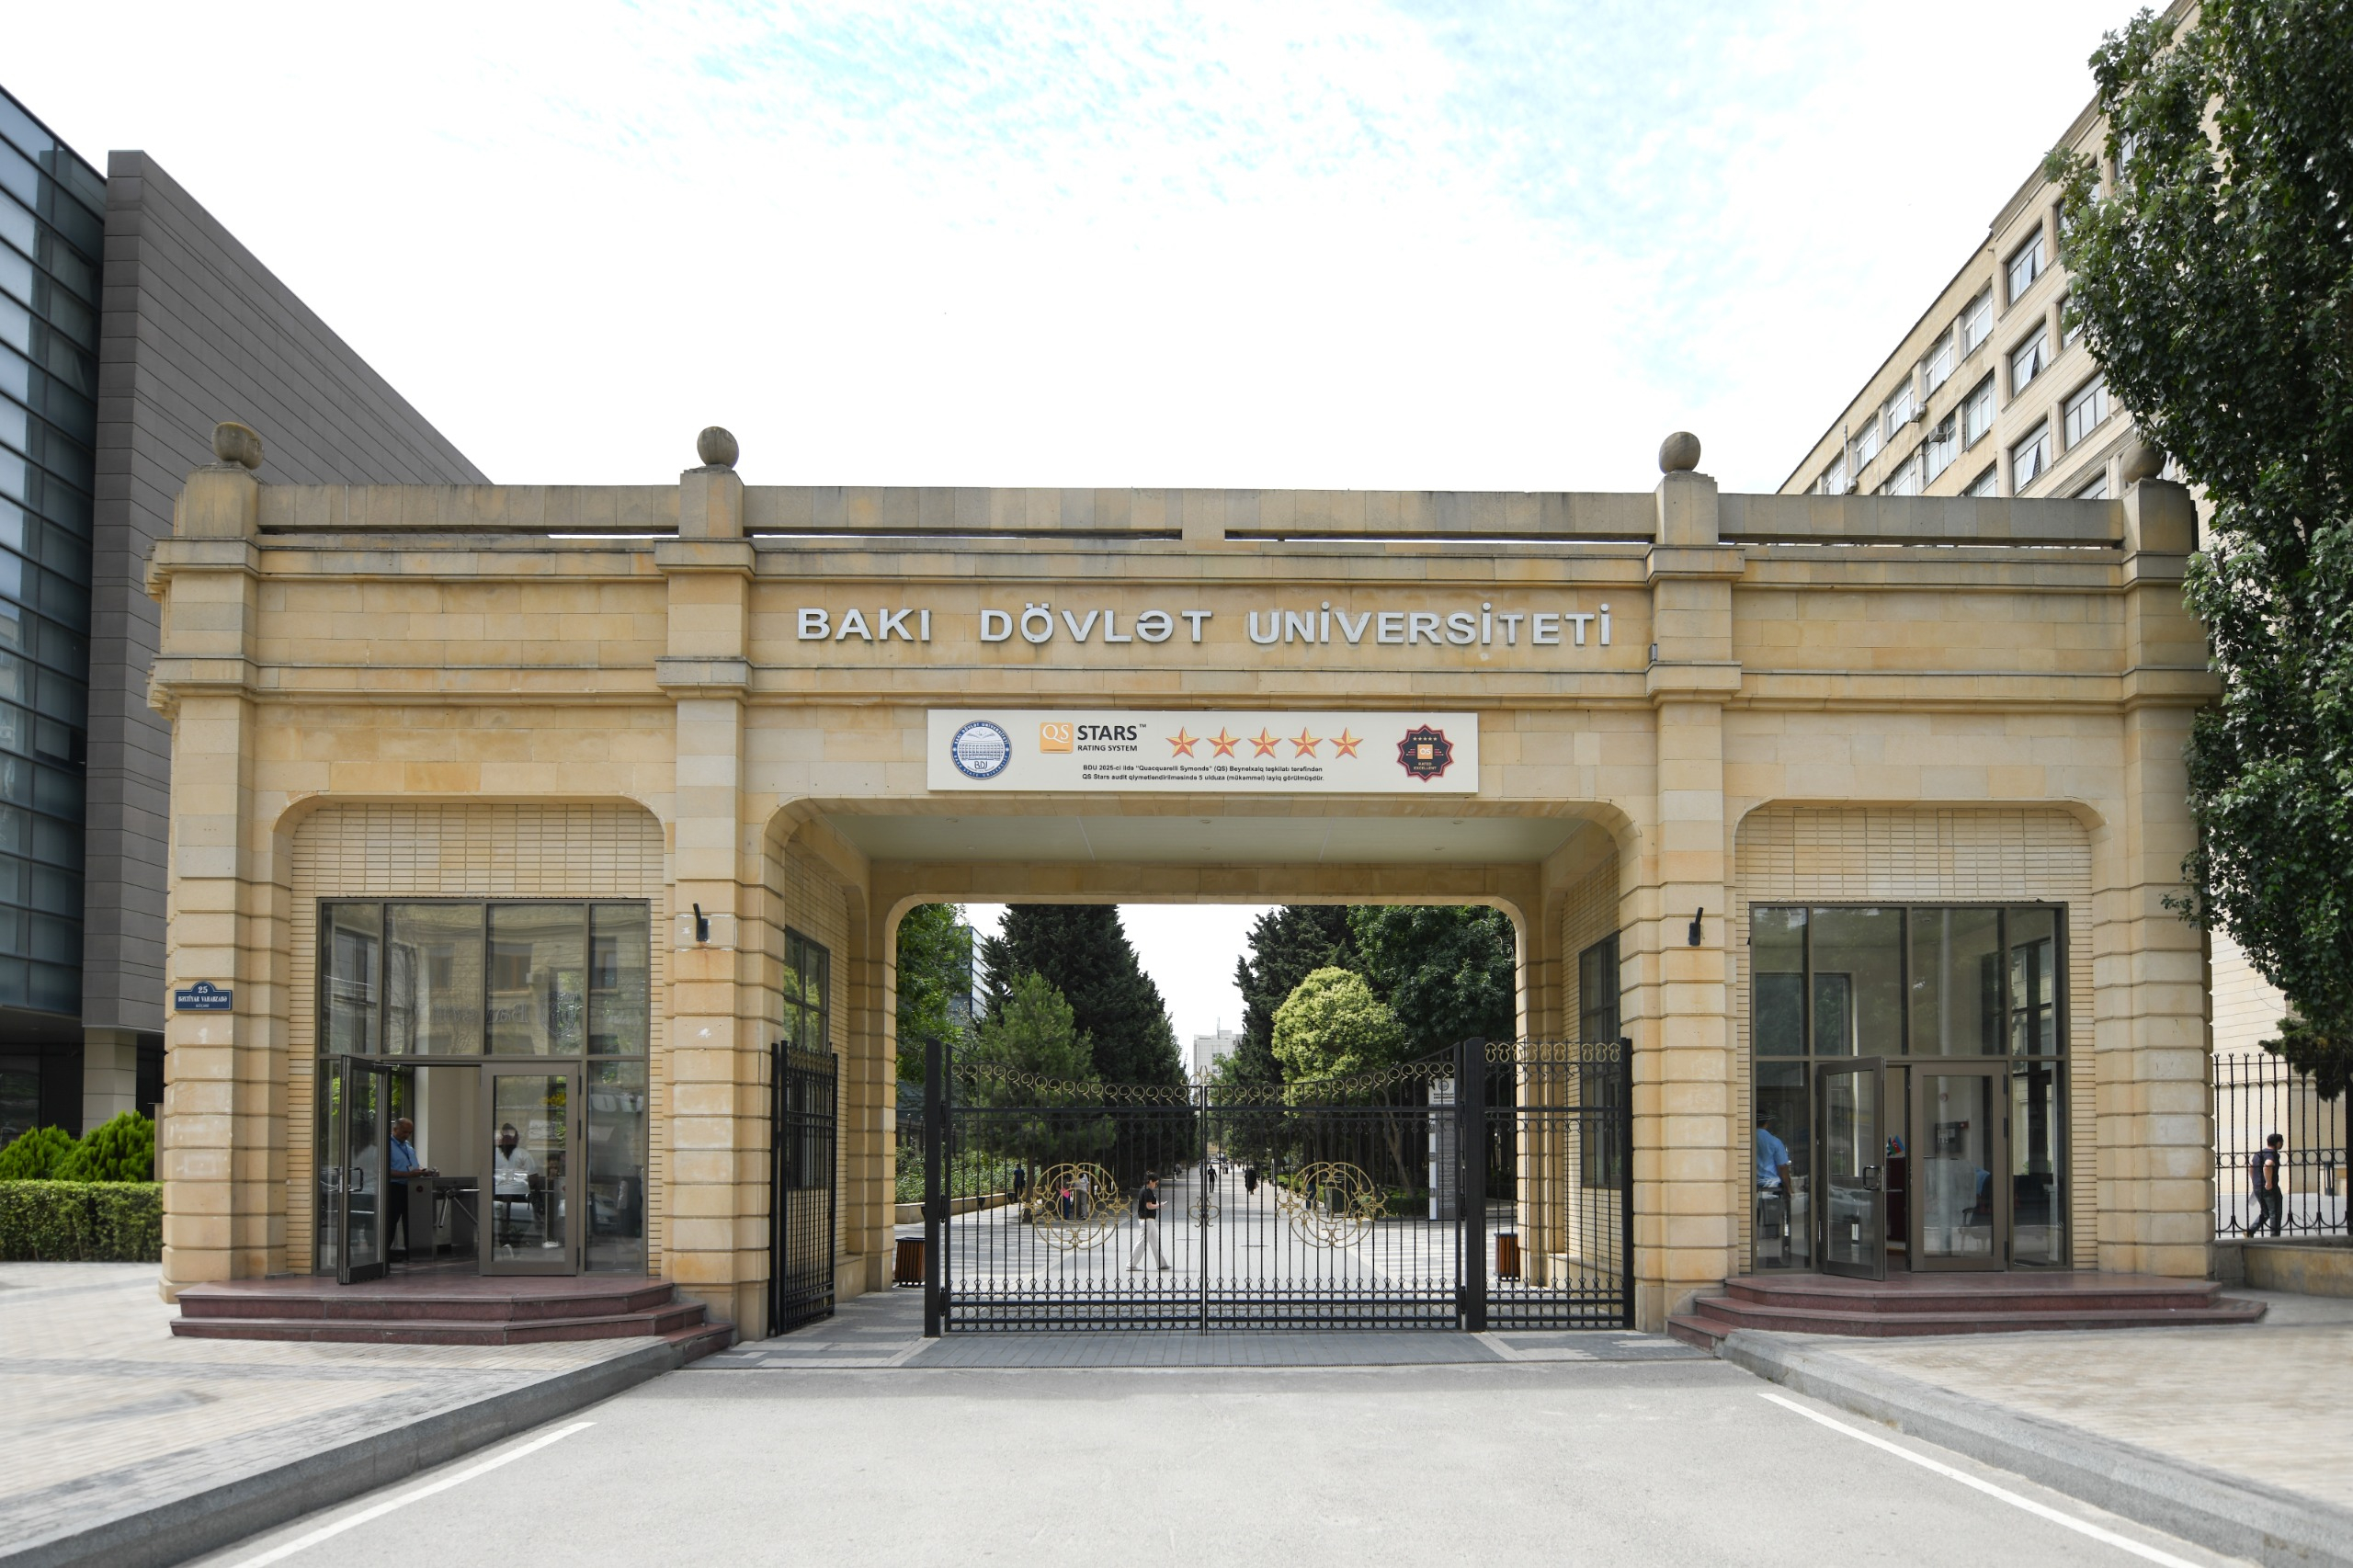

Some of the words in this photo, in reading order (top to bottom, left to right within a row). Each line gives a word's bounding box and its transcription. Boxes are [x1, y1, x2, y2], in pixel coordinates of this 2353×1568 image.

[797, 608, 932, 641] BAKI
[980, 602, 1212, 642] DÖVLƏT
[1248, 601, 1610, 645] UNİVERSİTETİ
[1042, 724, 1070, 743] QS
[1077, 725, 1138, 740] STARS
